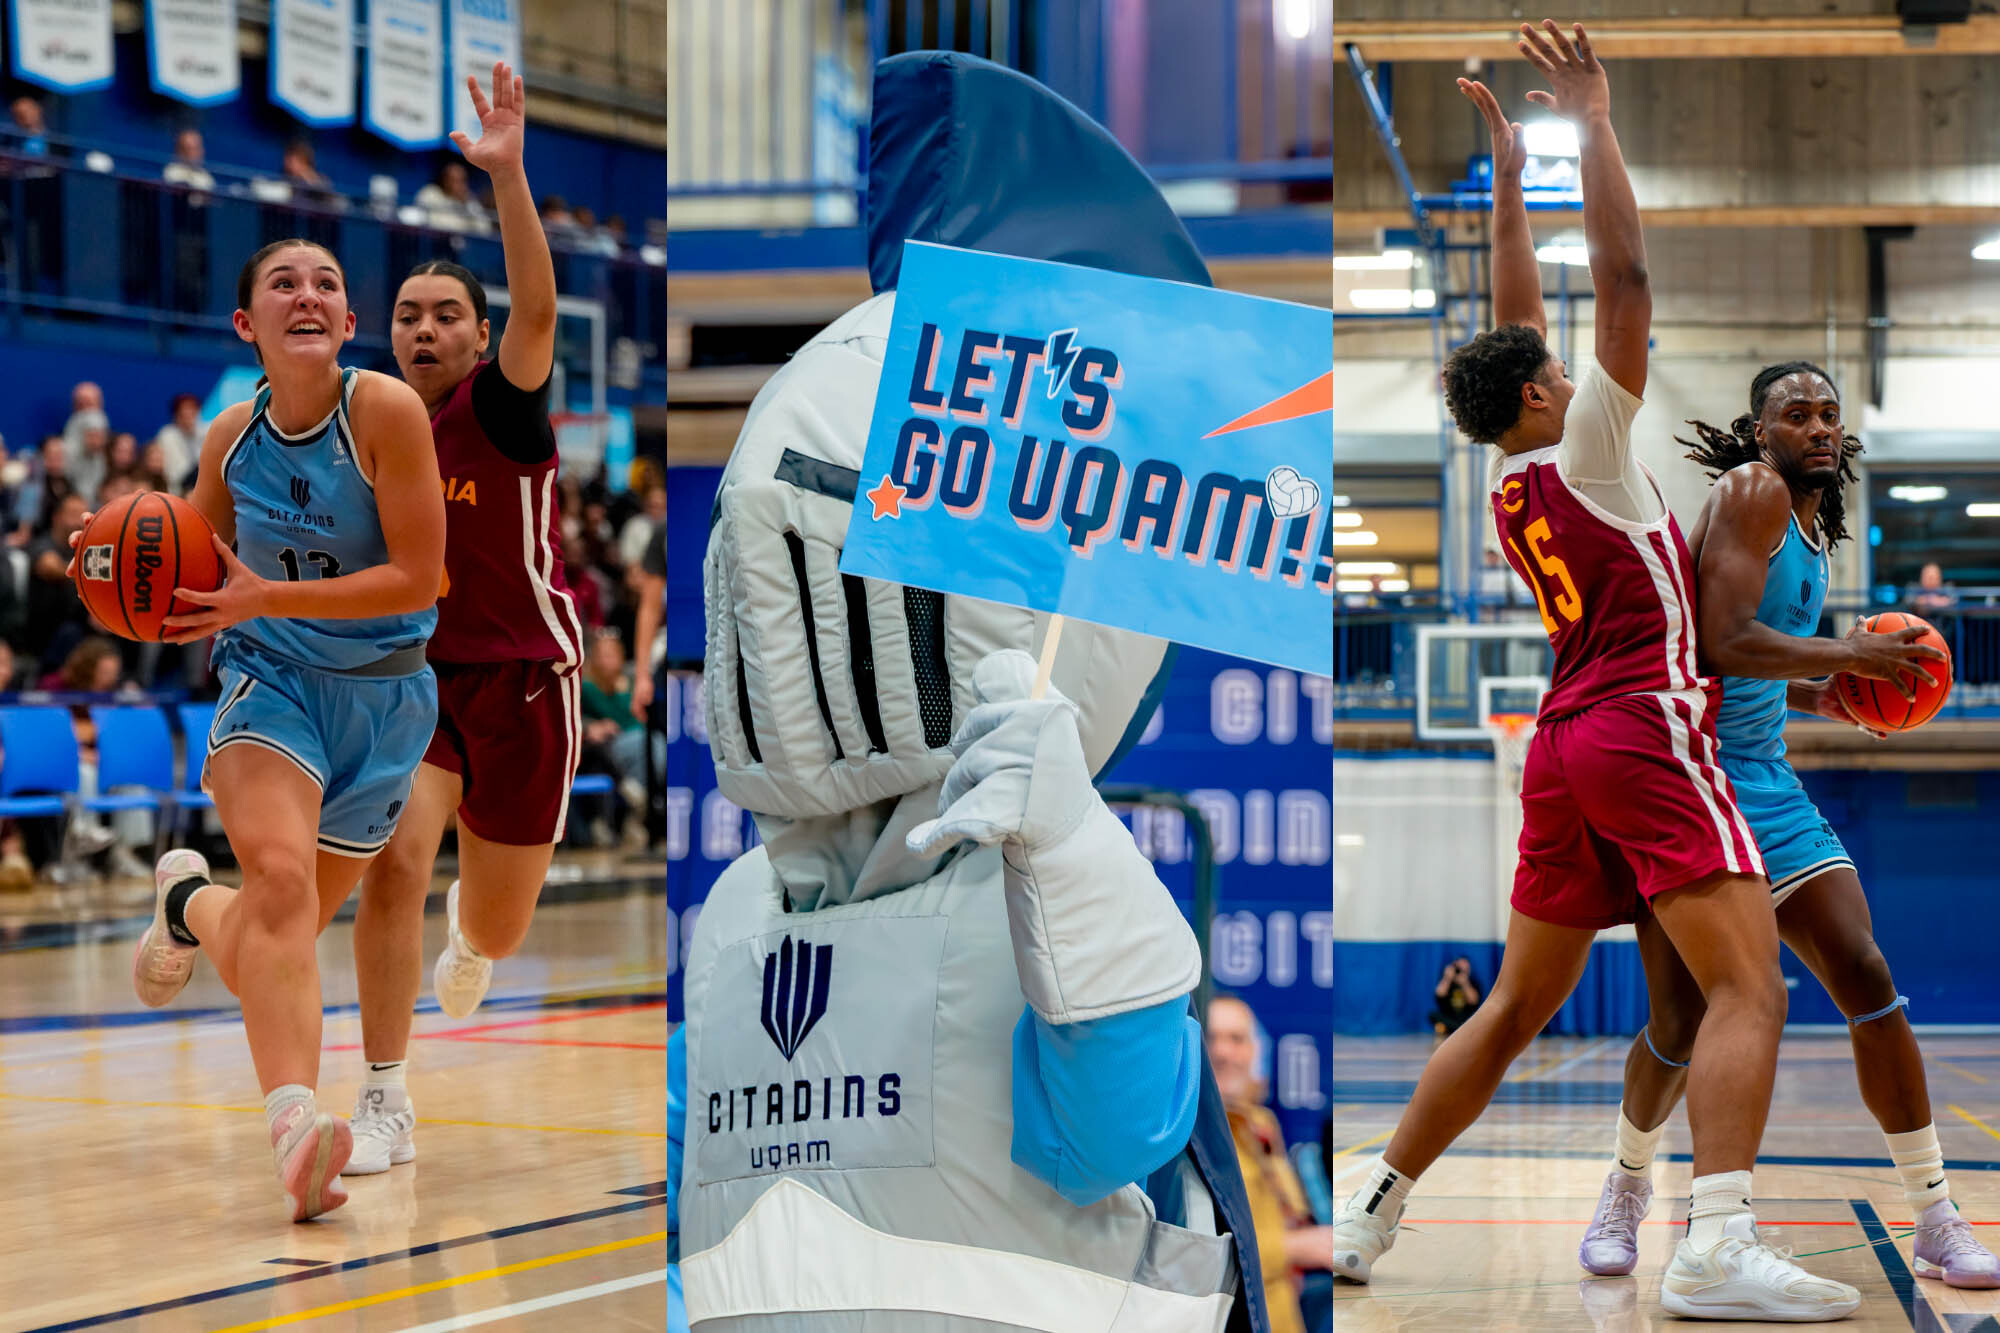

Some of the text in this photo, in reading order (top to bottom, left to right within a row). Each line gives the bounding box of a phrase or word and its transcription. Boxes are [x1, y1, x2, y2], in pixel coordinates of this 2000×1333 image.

[908, 322, 1121, 438] LET'S
[891, 417, 995, 515] GO
[133, 515, 164, 614] Wilson
[268, 508, 335, 528] CITADINS
[1507, 515, 1583, 635] 15
[709, 1073, 901, 1134] CITADINS
[751, 1140, 831, 1170] UQAM
